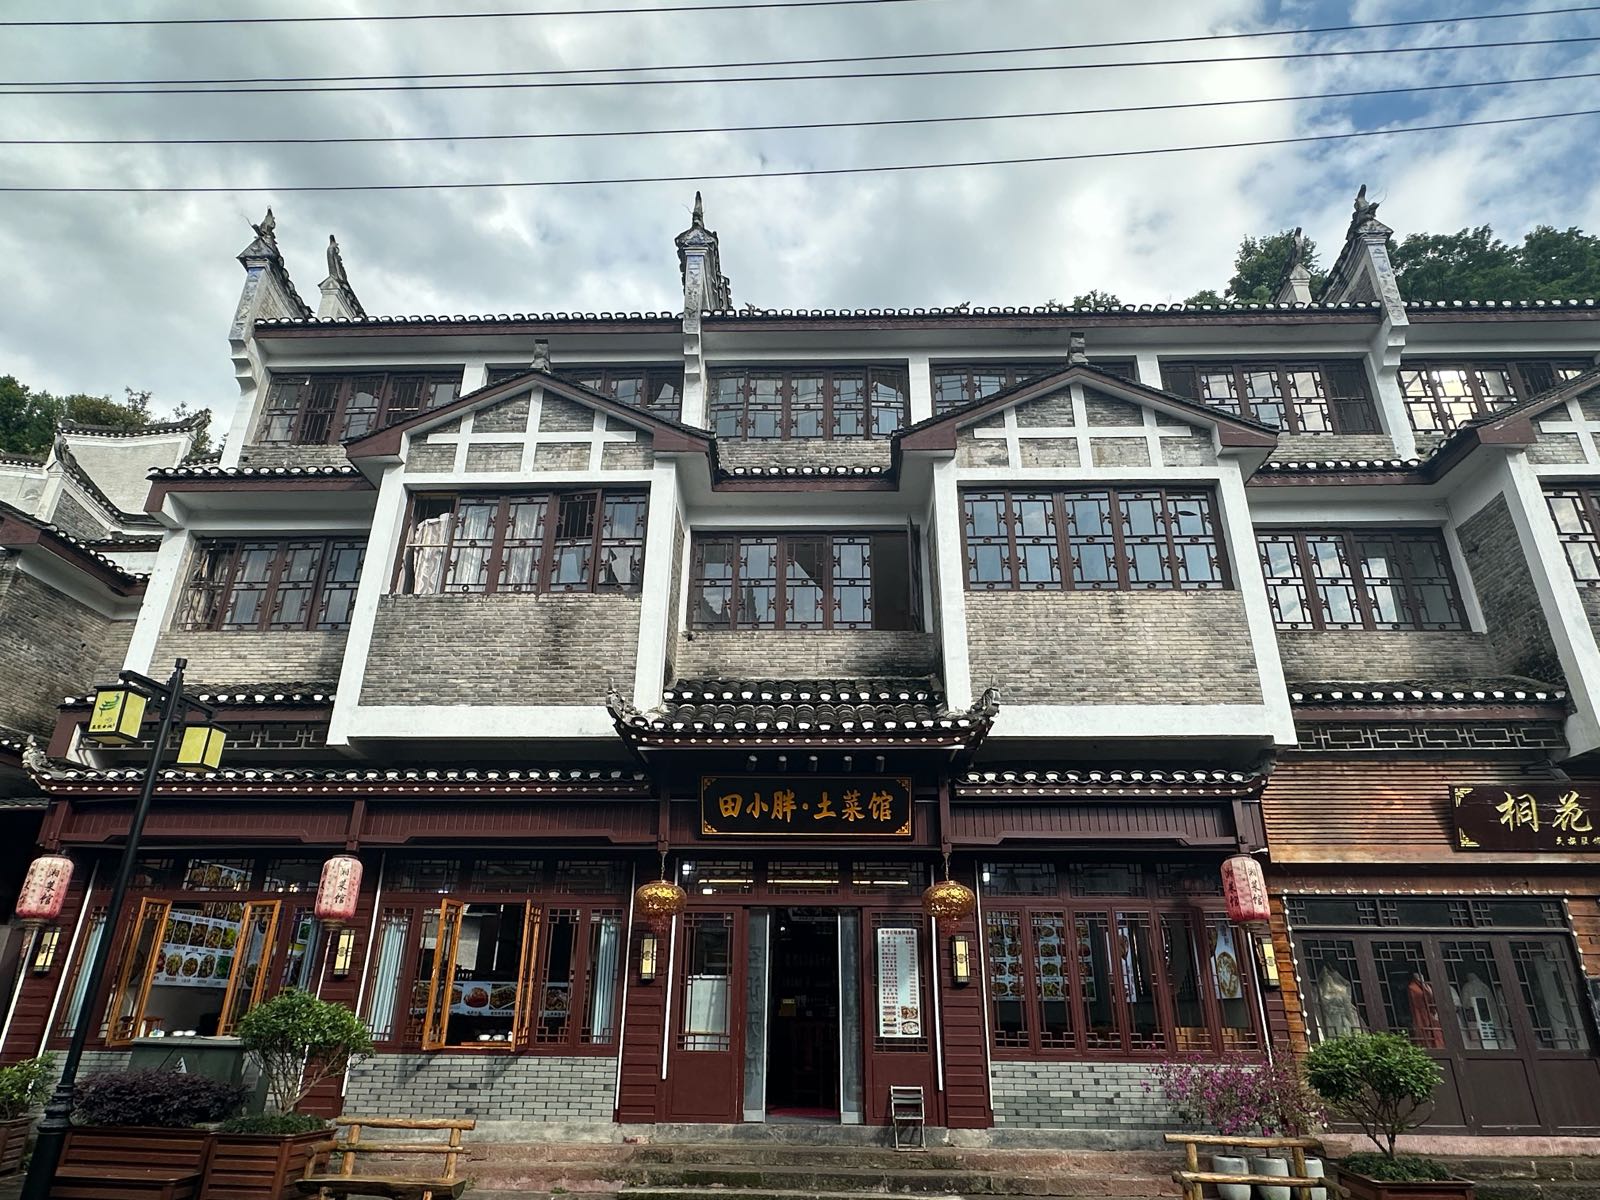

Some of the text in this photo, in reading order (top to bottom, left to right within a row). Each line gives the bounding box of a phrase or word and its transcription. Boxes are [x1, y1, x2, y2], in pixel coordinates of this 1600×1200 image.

[718, 789, 894, 822] 田小胖·土菜馆
[1495, 790, 1593, 832] 桐花
